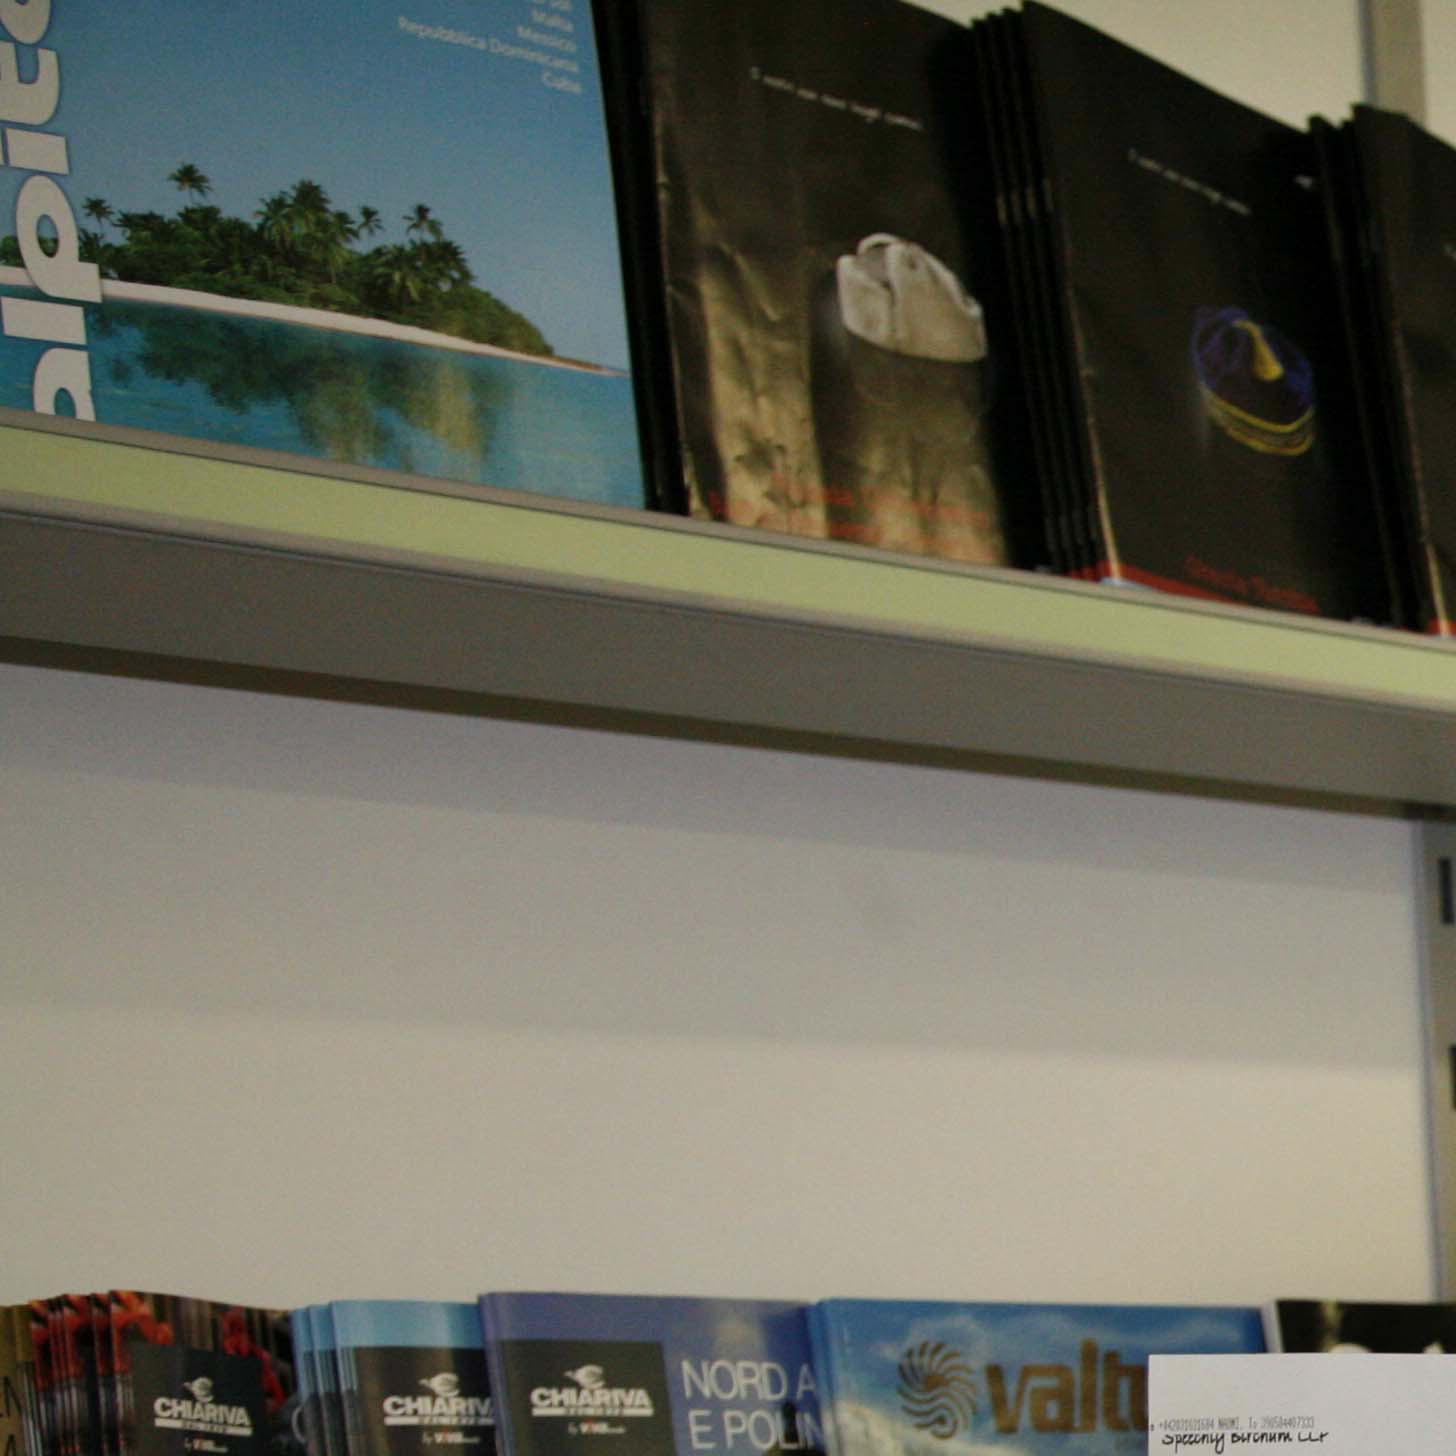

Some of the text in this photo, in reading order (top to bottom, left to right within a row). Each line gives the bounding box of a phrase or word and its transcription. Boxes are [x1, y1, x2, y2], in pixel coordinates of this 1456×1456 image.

[681, 1360, 788, 1400] NORD
[154, 1397, 250, 1426] CHIARIVA
[383, 1395, 495, 1416] CHIARIV
[530, 1387, 653, 1408] CHIARIVA
[688, 1409, 716, 1449] E
